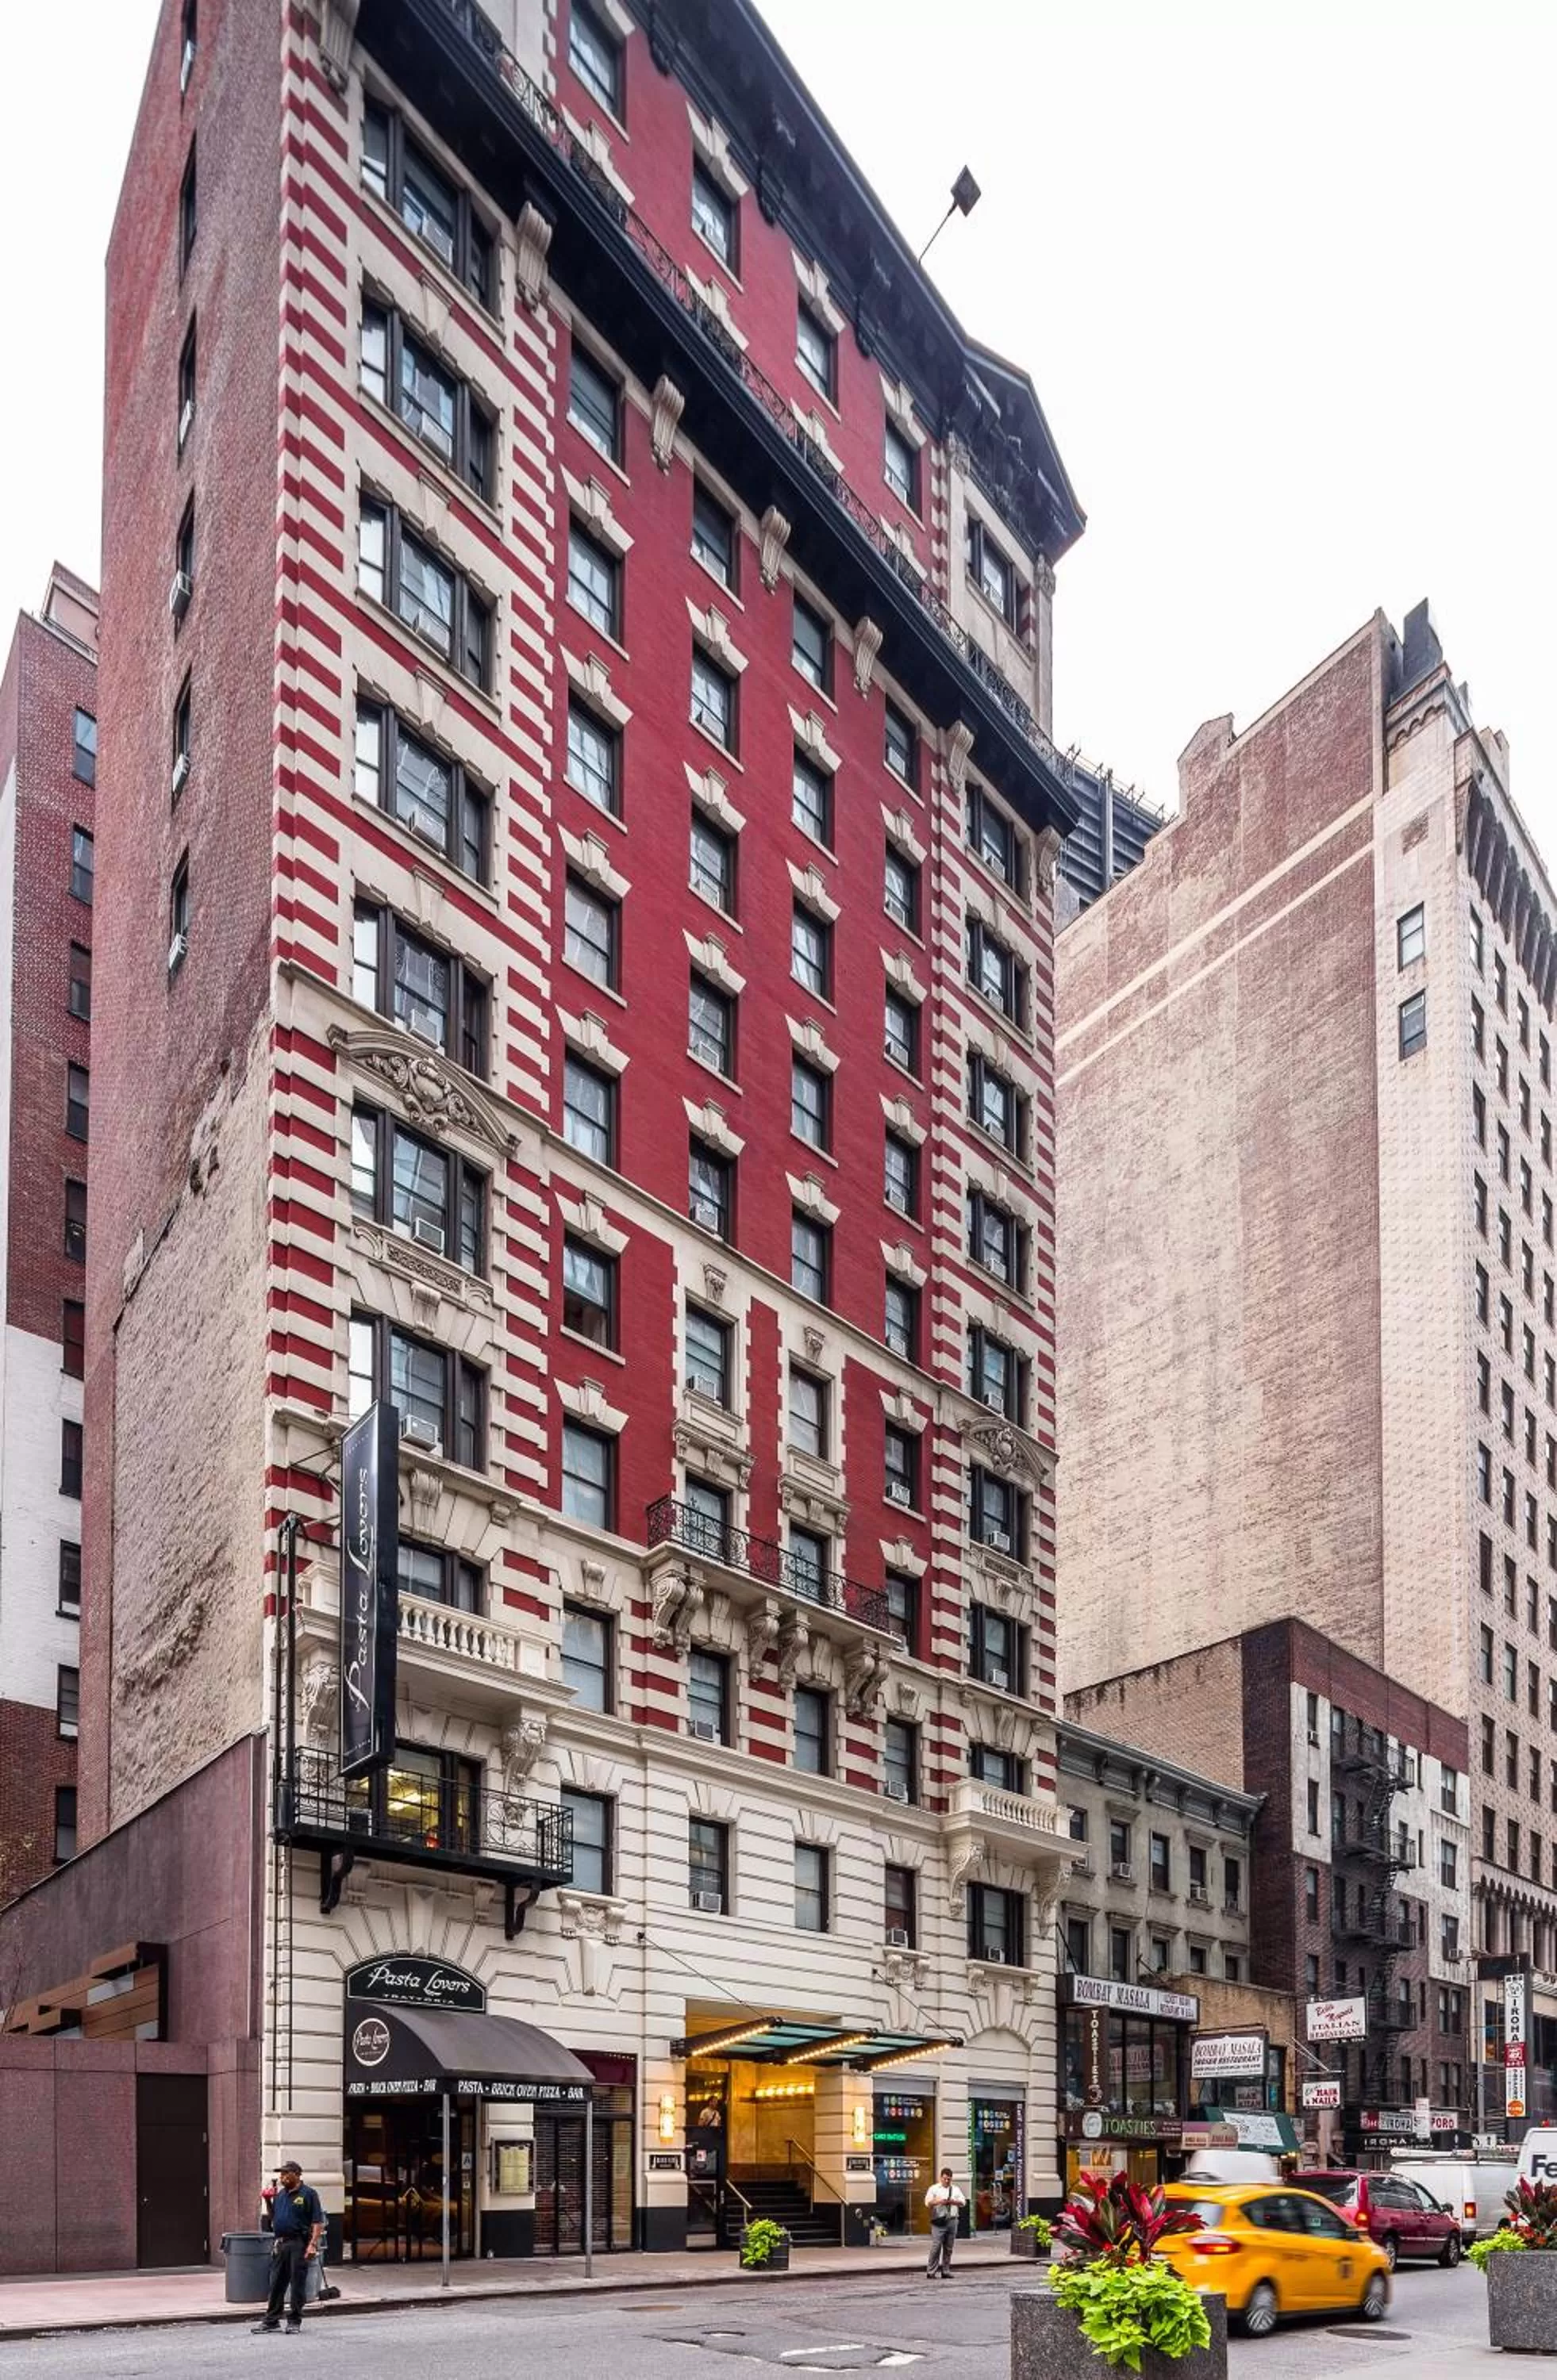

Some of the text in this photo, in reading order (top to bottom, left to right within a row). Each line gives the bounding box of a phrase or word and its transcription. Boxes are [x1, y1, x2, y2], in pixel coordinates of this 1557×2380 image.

[348, 1468, 373, 1580] Lovers
[344, 1591, 370, 1712] Pasta
[367, 1963, 471, 1996] Pasta Lovers
[1077, 1979, 1113, 2002] BOMBAY
[1116, 1987, 1150, 2010] MASALA
[1312, 2021, 1359, 2030] ITALIAN
[1510, 1998, 1519, 2042] IROHA
[1090, 2010, 1099, 2084] TOASTIES
[458, 2079, 584, 2100] PASTA BRICK OVEN PIZZA BAR
[1312, 2096, 1338, 2105] NAILS
[1317, 2087, 1338, 2097] HAIR
[1104, 2118, 1156, 2135] TOASTIES
